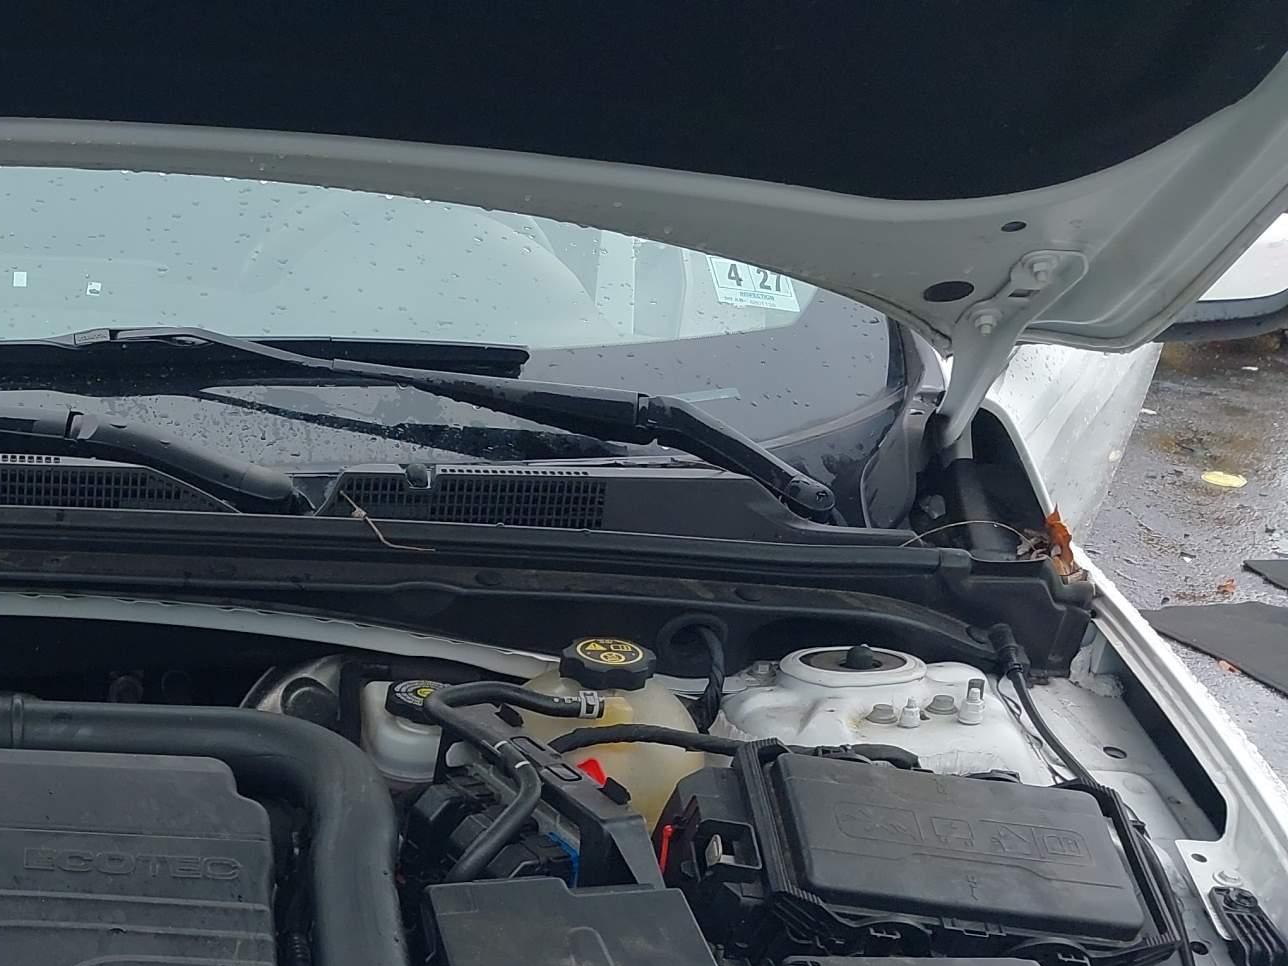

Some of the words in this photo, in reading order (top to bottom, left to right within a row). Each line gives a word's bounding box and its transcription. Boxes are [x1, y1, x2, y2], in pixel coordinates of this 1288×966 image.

[727, 263, 743, 287] 4
[756, 269, 782, 292] 27
[23, 847, 244, 880] ECOTEC
